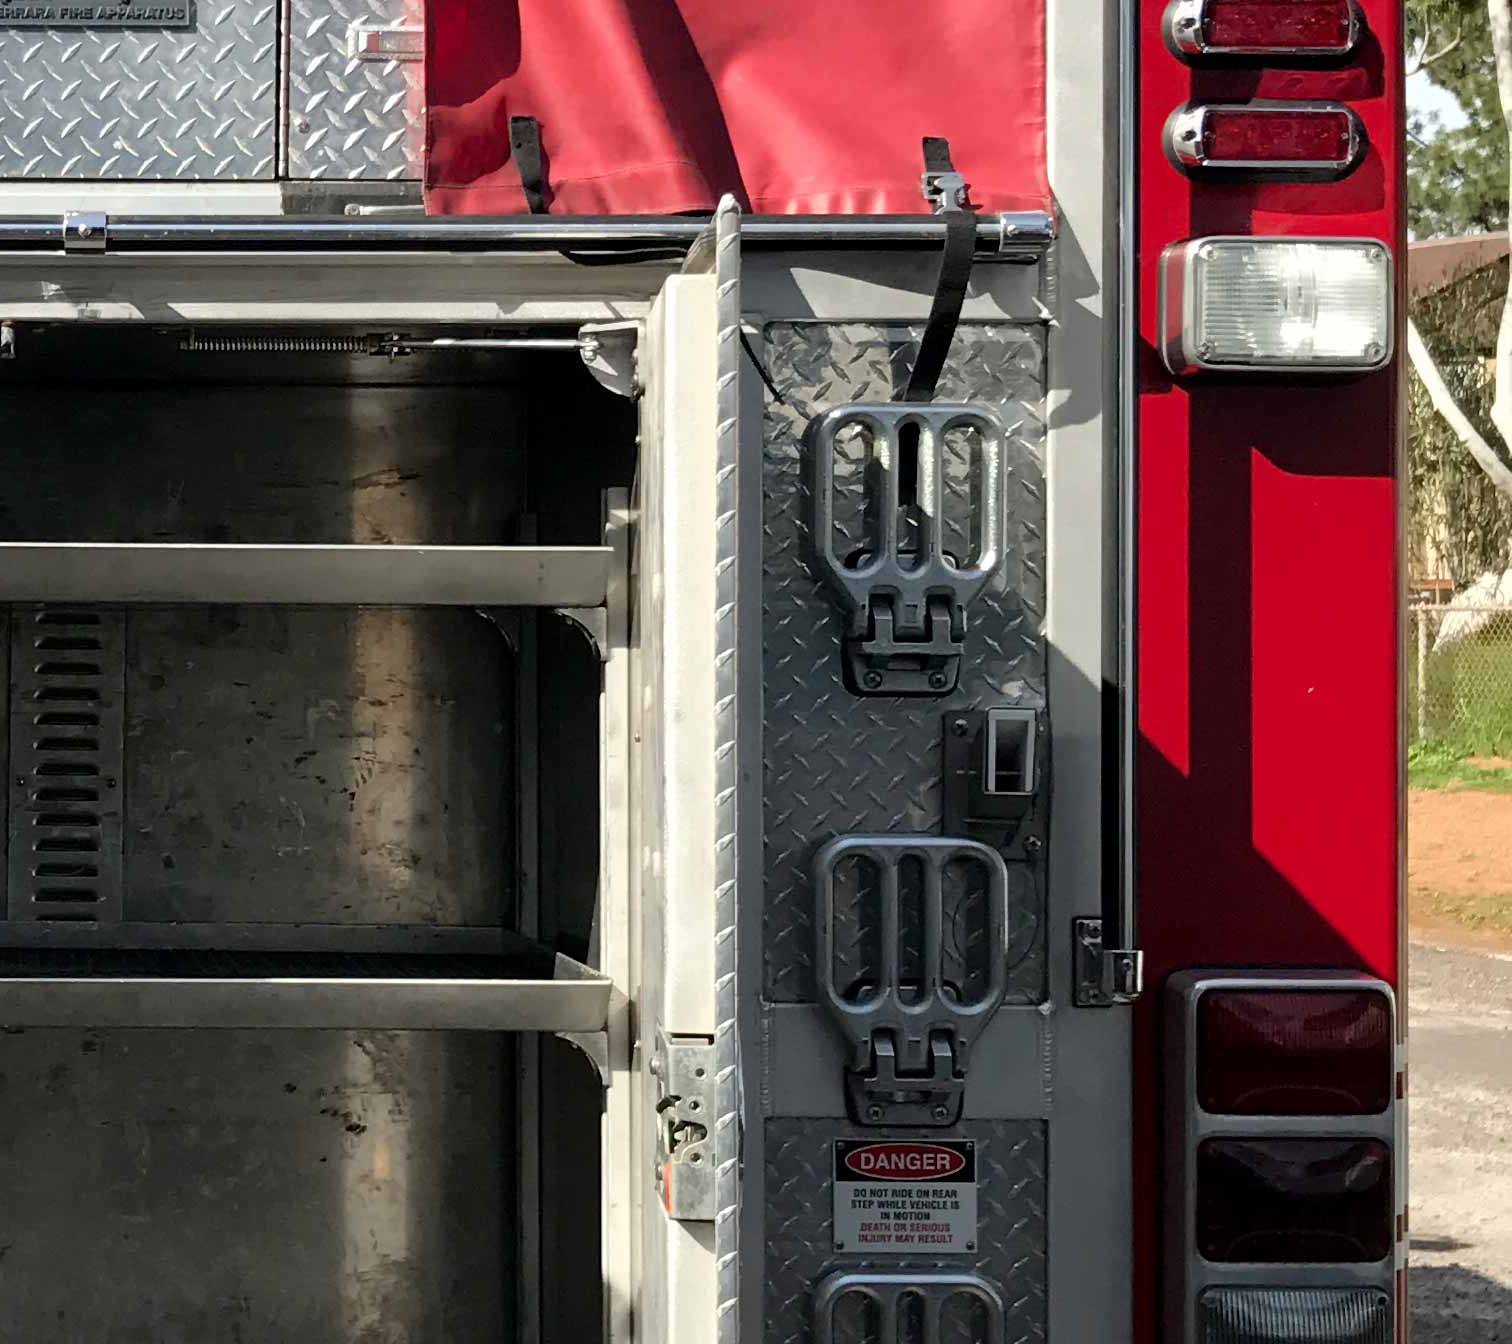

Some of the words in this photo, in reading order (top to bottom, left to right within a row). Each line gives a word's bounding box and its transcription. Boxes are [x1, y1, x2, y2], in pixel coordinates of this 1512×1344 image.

[59, 7, 94, 20] FIRE
[96, 7, 186, 20] APPARATUS
[860, 1152, 951, 1170] DANGER
[853, 1188, 867, 1198] DO
[870, 1188, 889, 1198] NOT
[891, 1188, 913, 1198] RIDE
[916, 1189, 929, 1198] ON
[932, 1189, 958, 1199] REAR
[851, 1199, 874, 1209] STEP
[877, 1200, 907, 1209] WHILE
[909, 1200, 948, 1210] VEHICLE
[951, 1200, 960, 1210] IS
[880, 1211, 890, 1220] IN
[893, 1211, 930, 1221] MOTION
[860, 1222, 890, 1232] DEATH
[893, 1223, 907, 1232] OR
[909, 1223, 951, 1232] SERIOUS
[858, 1234, 892, 1243] INJURY
[895, 1234, 915, 1243] MAY
[918, 1234, 953, 1243] RESULT
